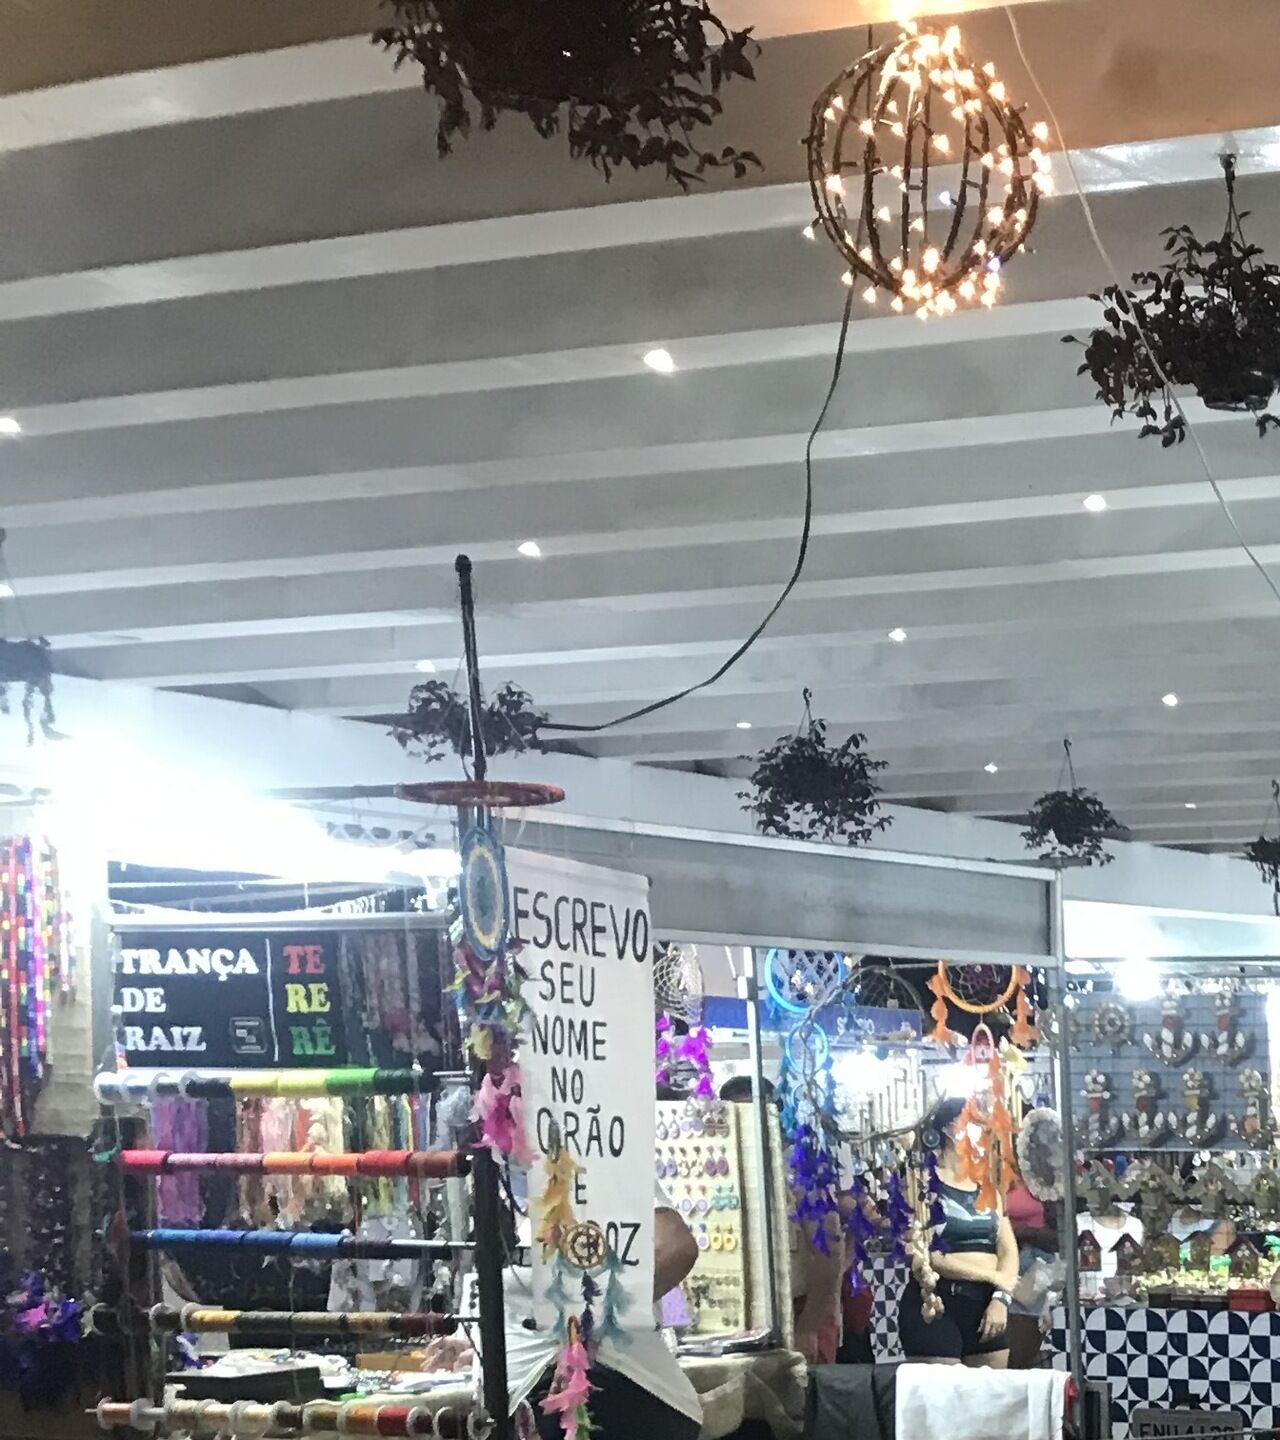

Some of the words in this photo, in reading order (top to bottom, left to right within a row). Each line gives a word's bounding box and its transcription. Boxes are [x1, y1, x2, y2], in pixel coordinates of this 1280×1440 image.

[513, 886, 649, 963] ESCREVO
[120, 947, 259, 982] TRANÇA
[283, 944, 326, 975] TE
[120, 986, 167, 1014] DE
[285, 982, 331, 1014] RE
[538, 959, 595, 1008] SEU
[124, 1025, 207, 1052] RAIZ
[289, 1017, 336, 1056] RÊ
[531, 1014, 607, 1061] NOME
[551, 1066, 584, 1105] NO
